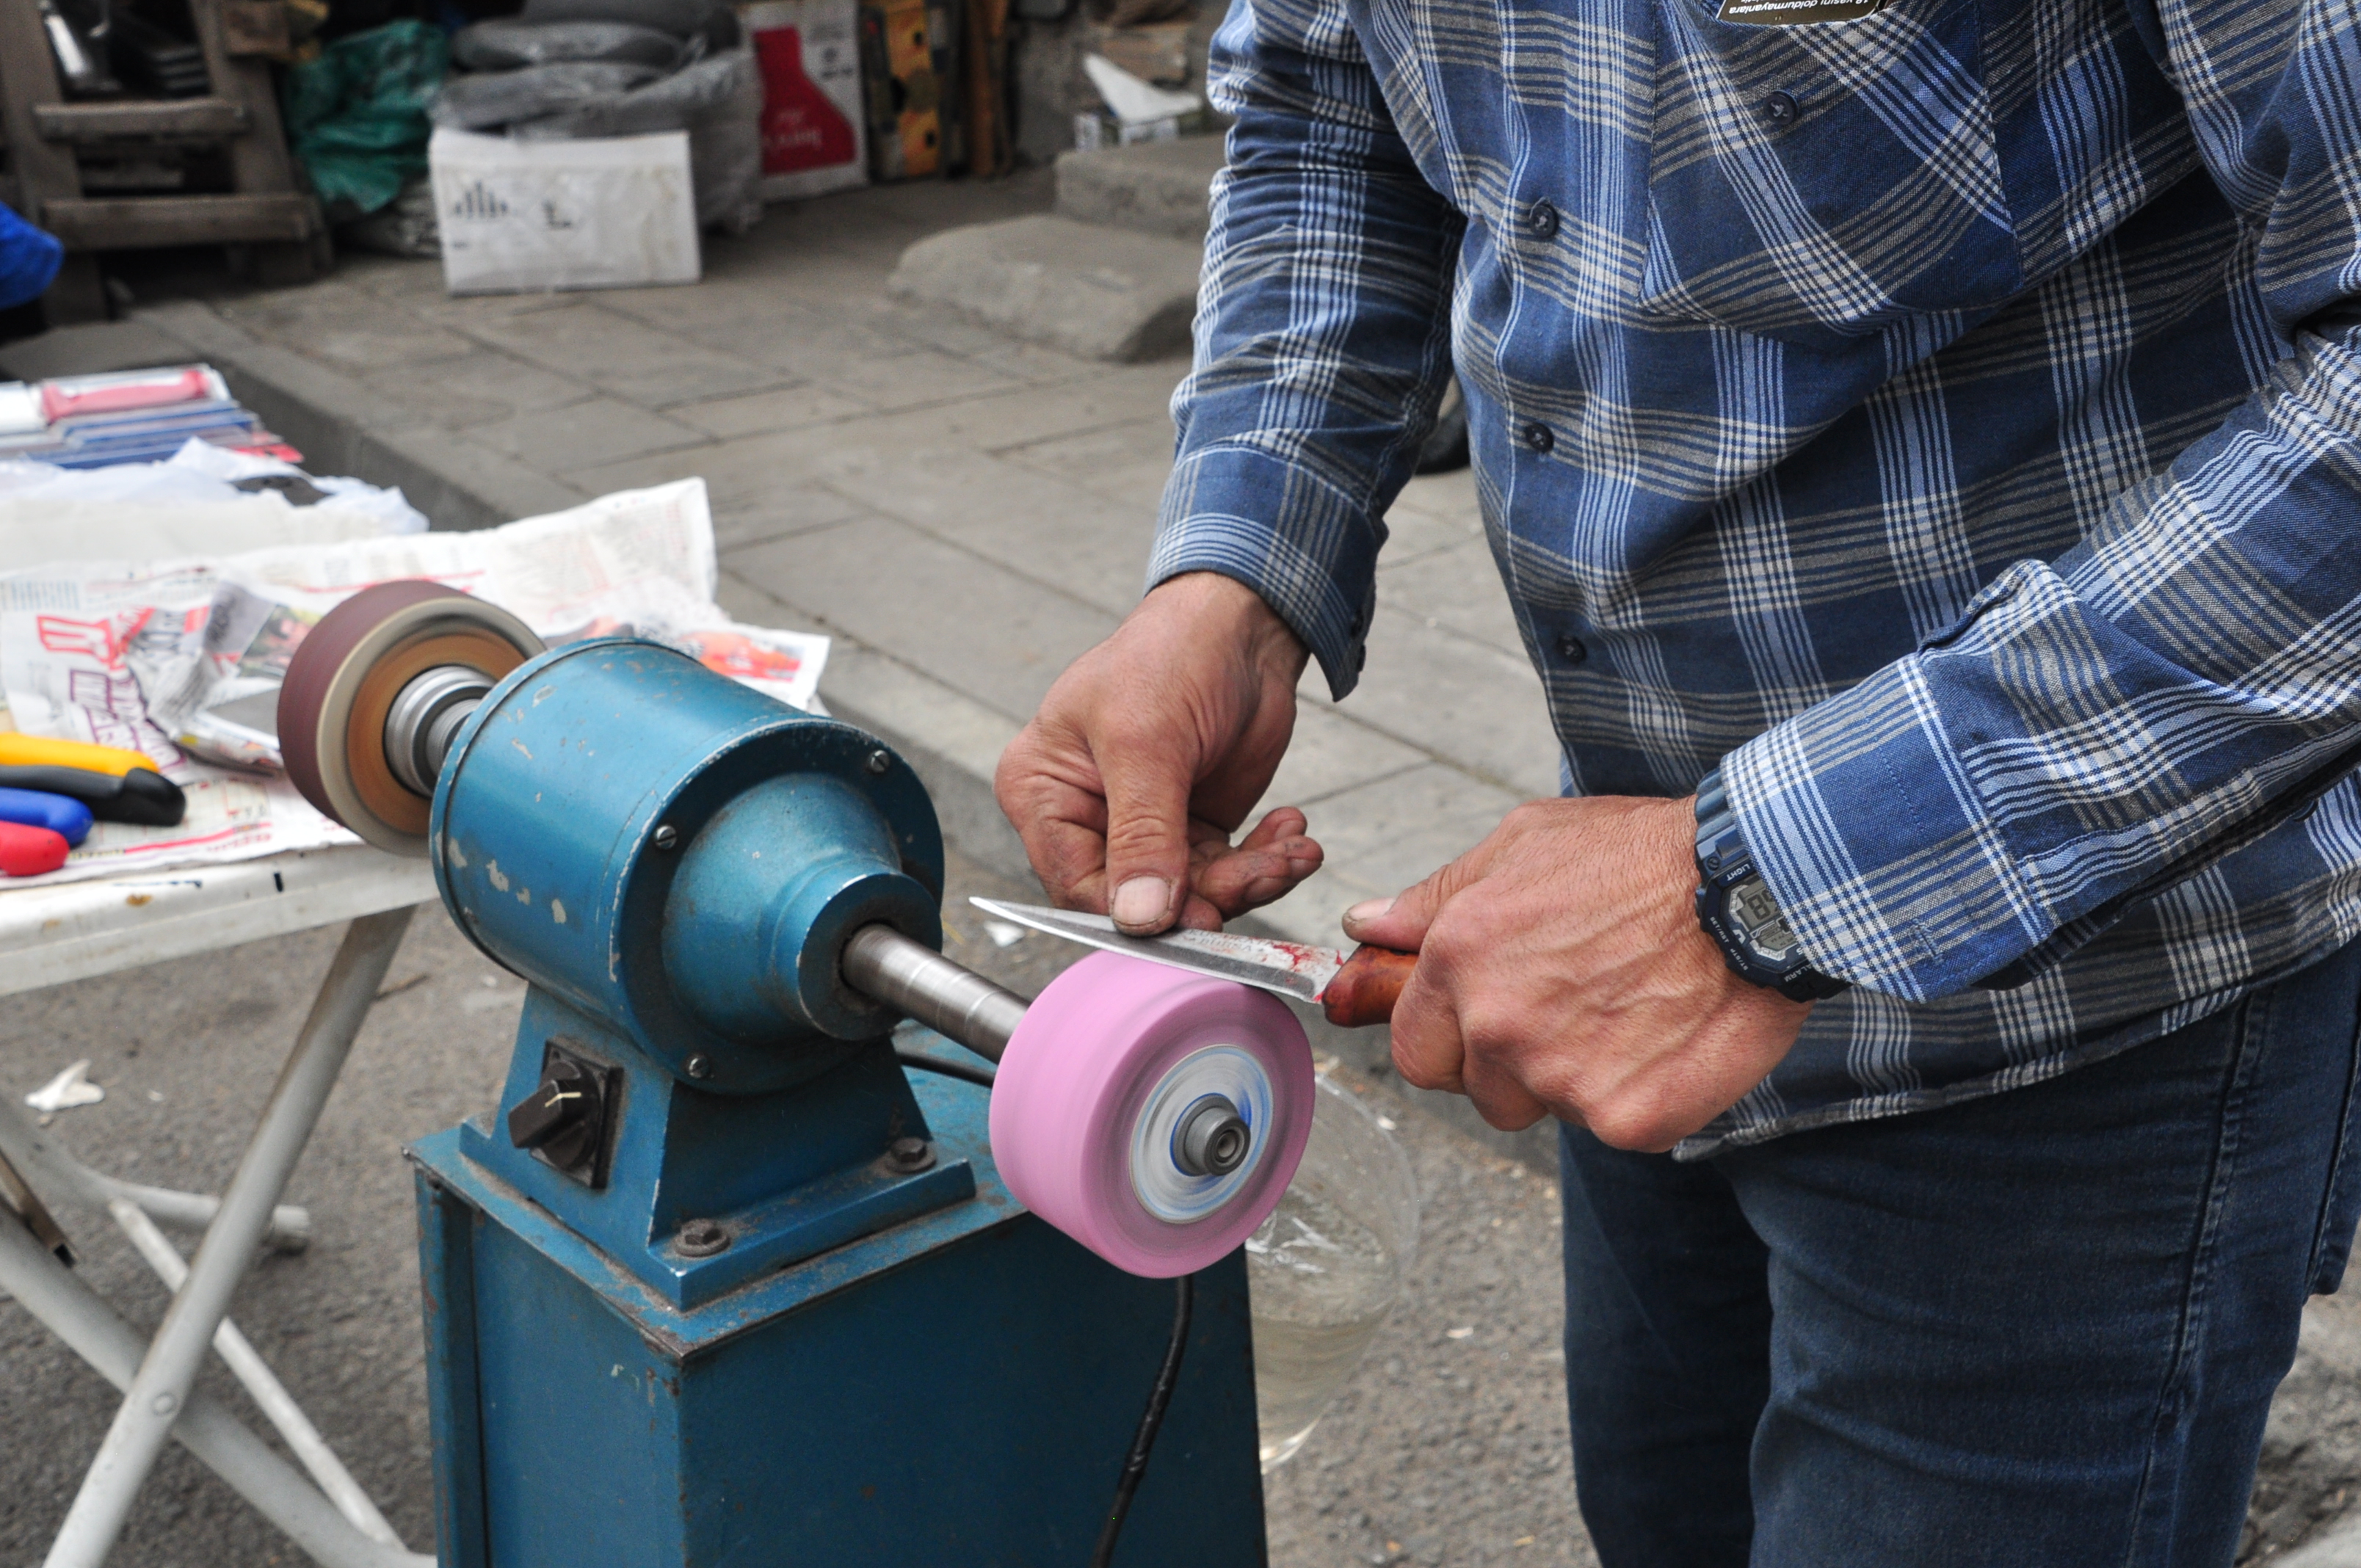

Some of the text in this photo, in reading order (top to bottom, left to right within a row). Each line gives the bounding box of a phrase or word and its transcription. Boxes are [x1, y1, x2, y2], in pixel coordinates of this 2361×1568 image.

[1729, 0, 1818, 14] doldurmayanlara
[1726, 863, 1751, 881] LIGHT
[1784, 962, 1813, 981] ALARM
